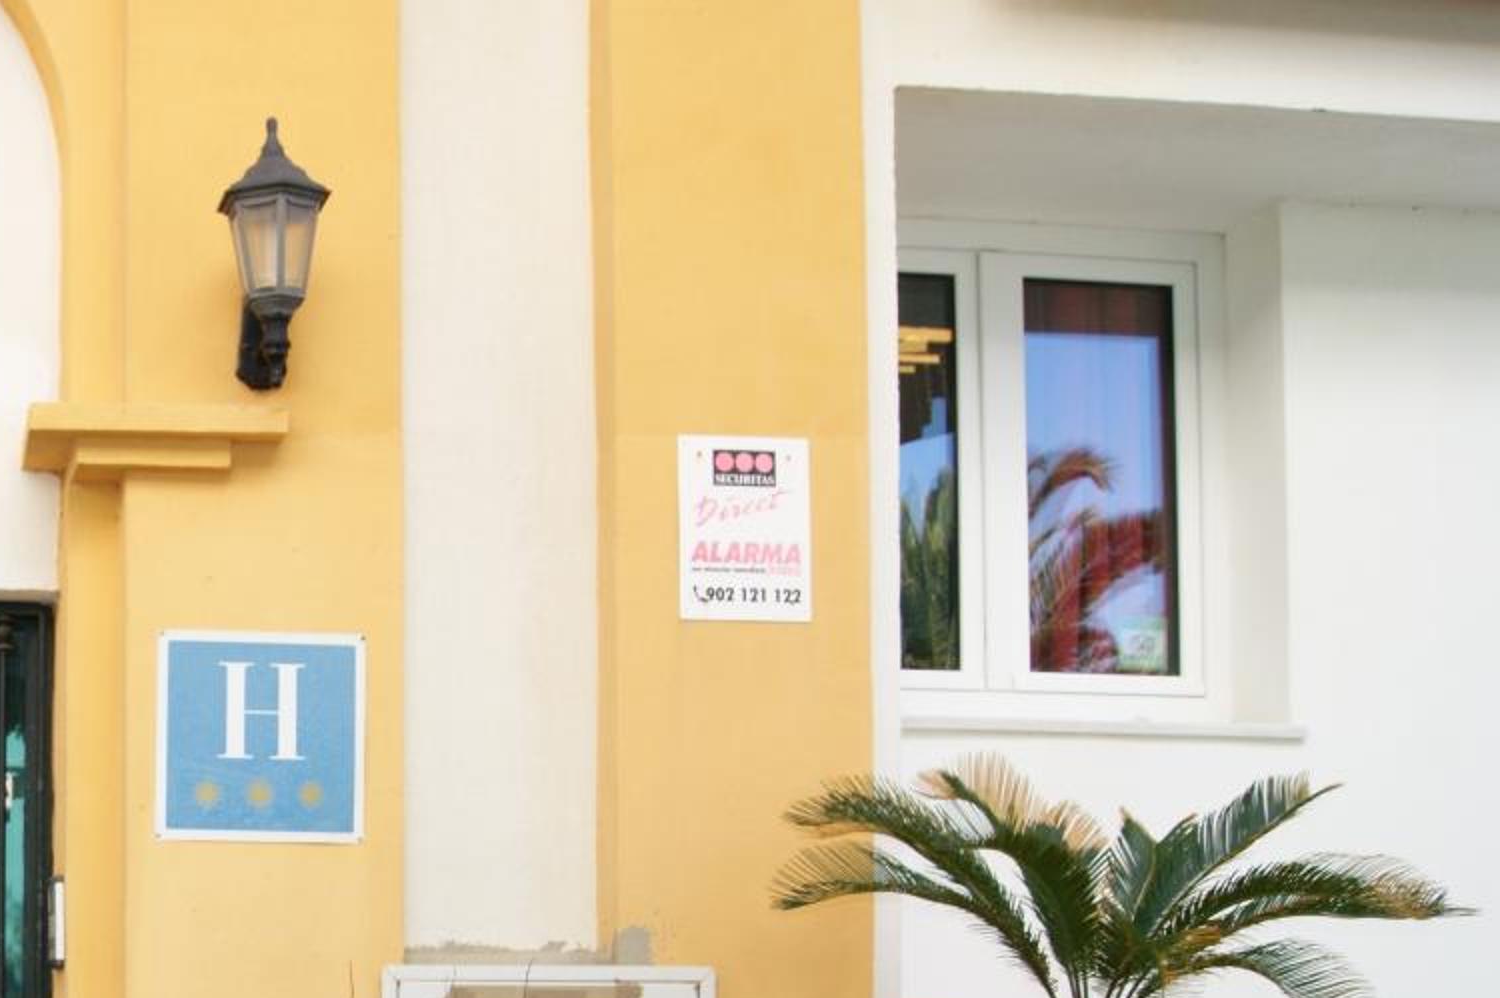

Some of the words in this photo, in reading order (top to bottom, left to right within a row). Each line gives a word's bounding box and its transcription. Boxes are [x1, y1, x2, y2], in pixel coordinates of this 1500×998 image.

[692, 541, 801, 564] ALARMA
[706, 587, 735, 602] 902
[741, 588, 767, 603] 121
[774, 588, 802, 605] 122
[217, 661, 306, 760] H
